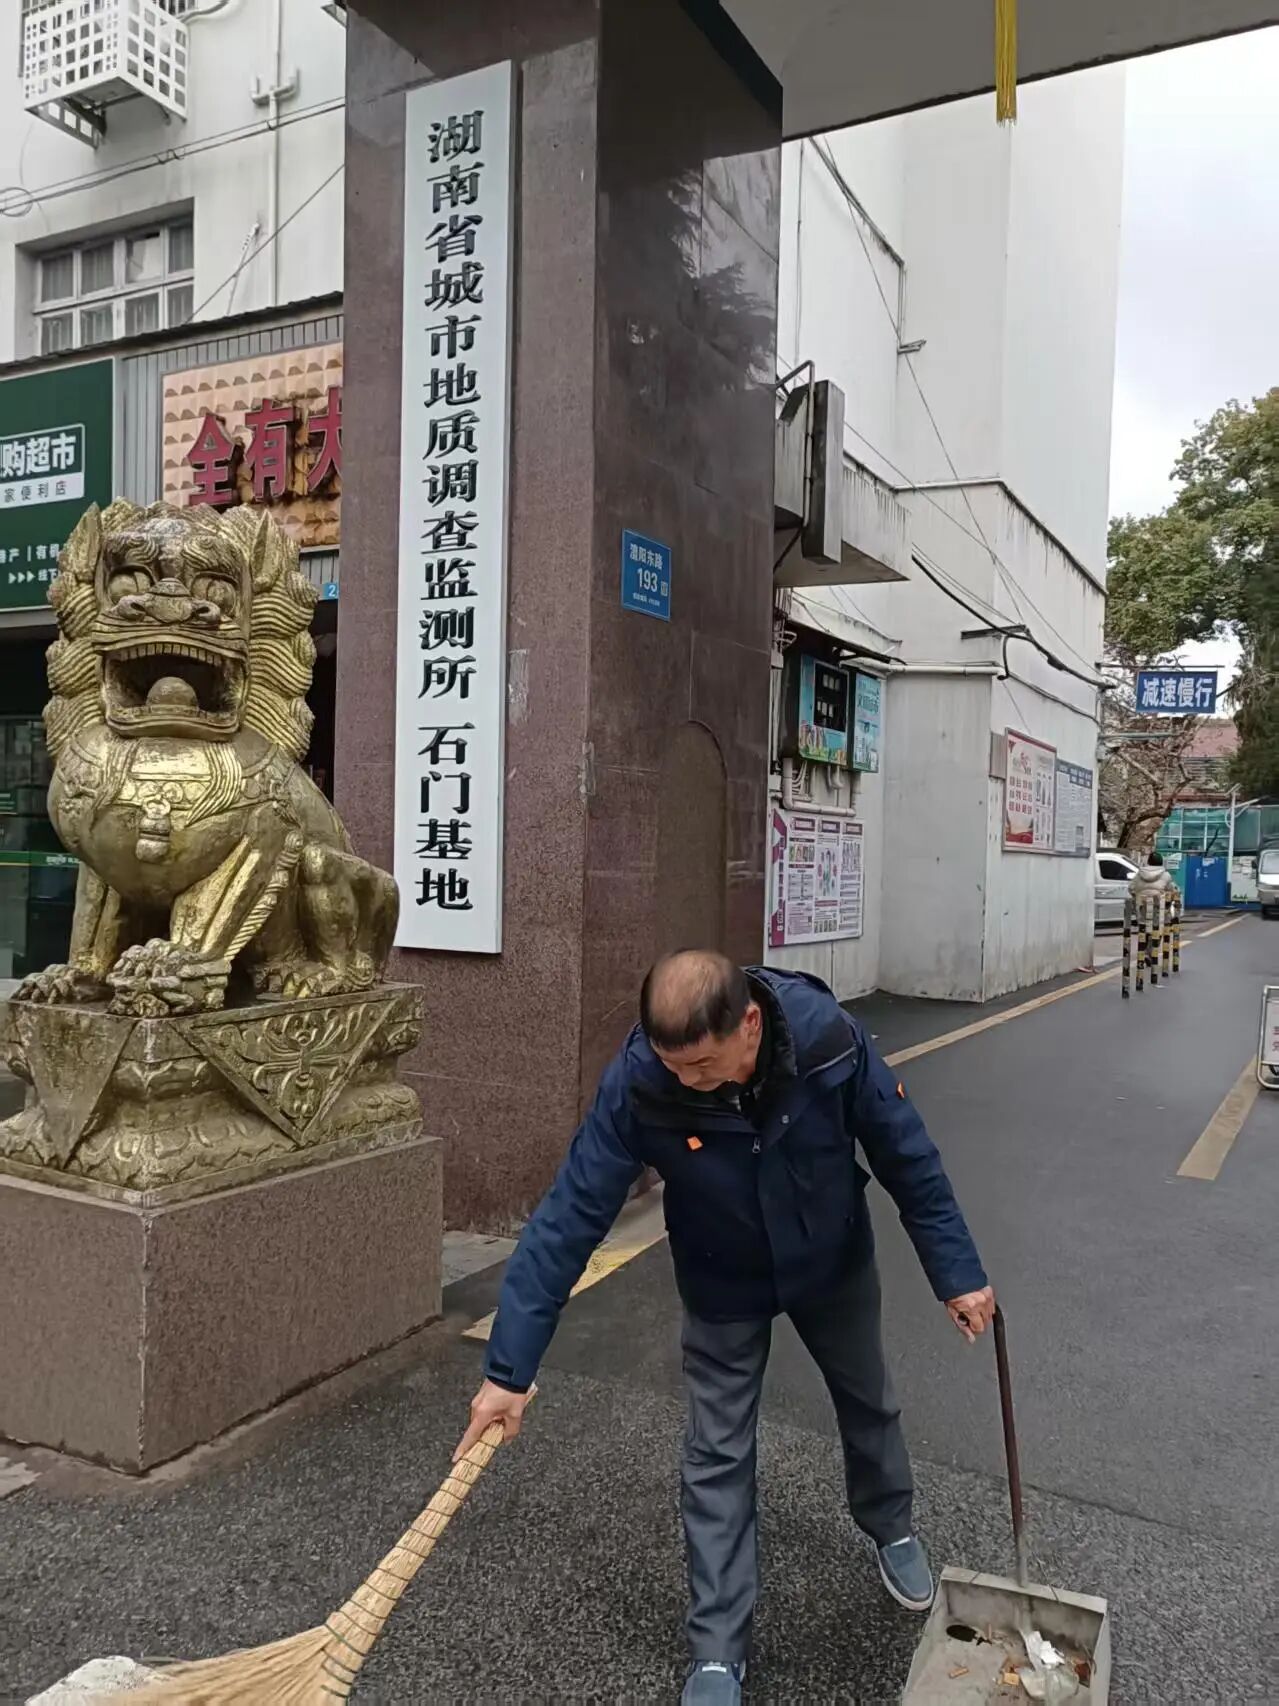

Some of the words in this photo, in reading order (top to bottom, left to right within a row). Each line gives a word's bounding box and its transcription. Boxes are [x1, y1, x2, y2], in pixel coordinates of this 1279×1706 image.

[418, 110, 485, 699] 湖南省城市地质调查监测所
[0, 432, 76, 478] 购超市
[637, 568, 658, 592] 193
[1141, 676, 1213, 709] 减速慢行
[413, 722, 476, 911] 石门基地
